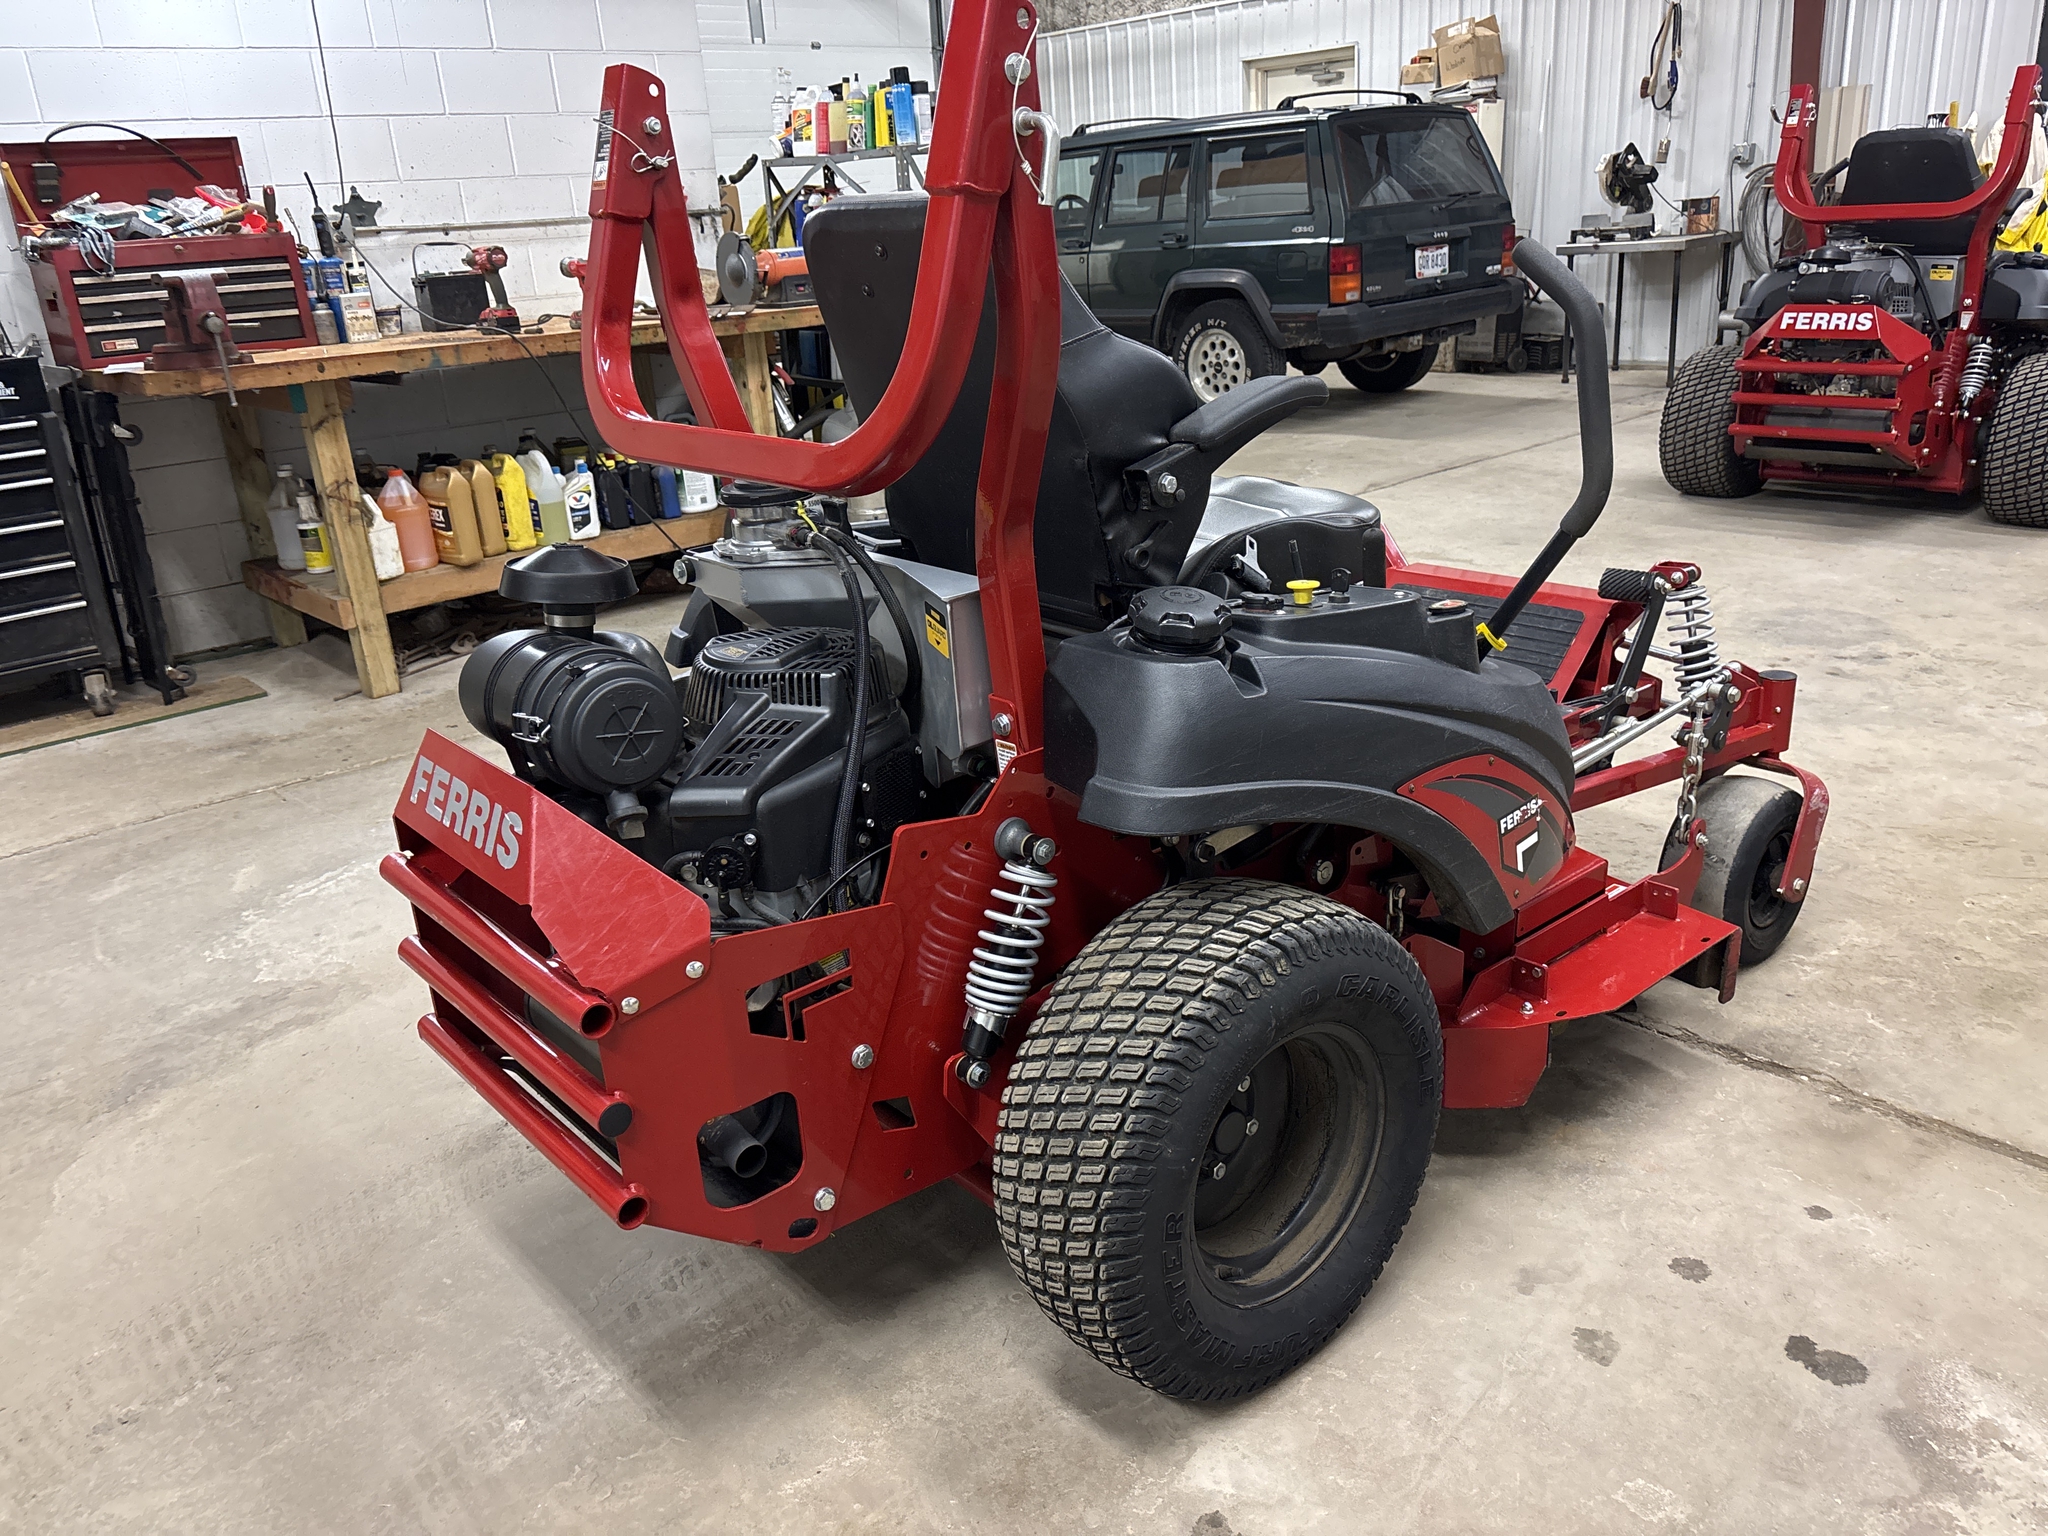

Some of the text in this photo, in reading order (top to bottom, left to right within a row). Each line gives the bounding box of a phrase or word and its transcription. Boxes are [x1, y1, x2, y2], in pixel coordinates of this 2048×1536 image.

[1780, 312, 1874, 331] FERRIS
[409, 754, 523, 870] FERRIS
[1335, 973, 1435, 1106] CARLISLE
[1163, 1211, 1236, 1368] MASTER
